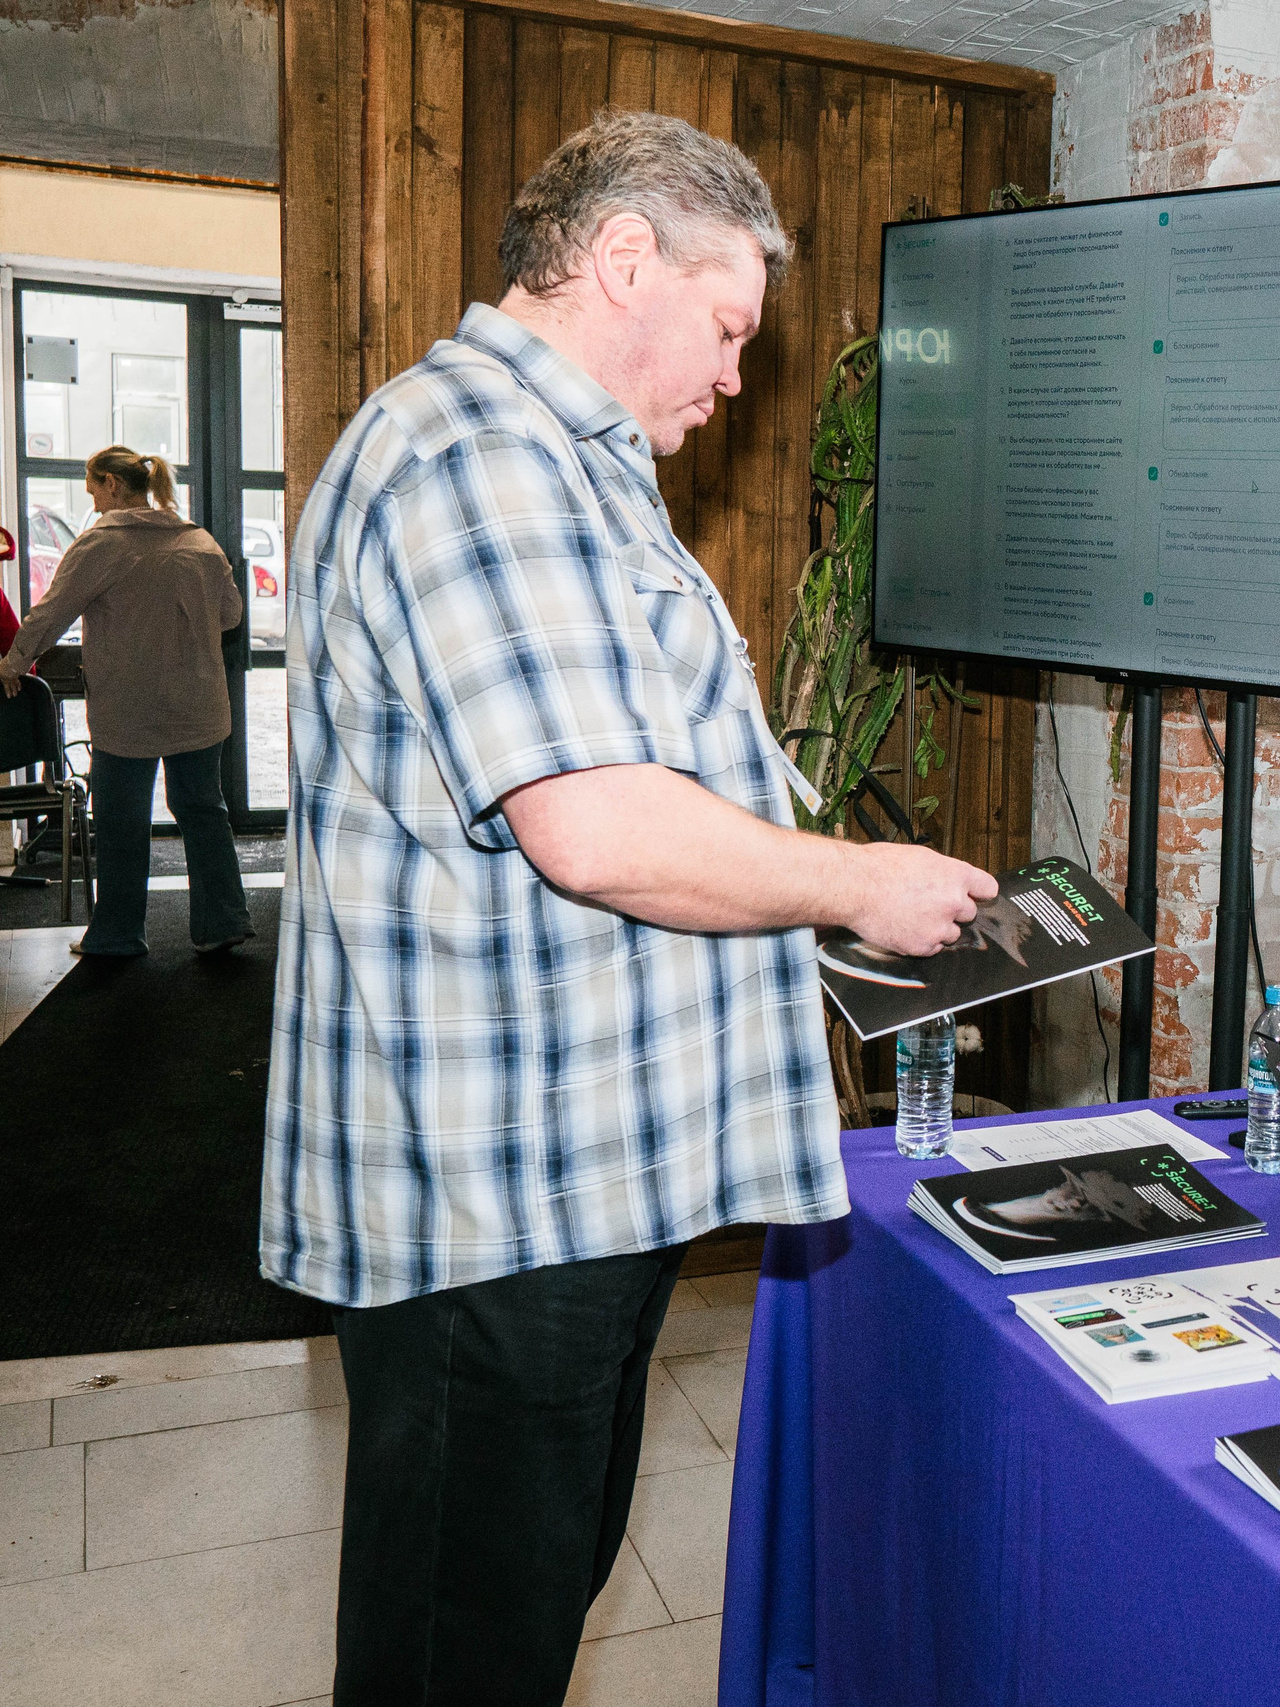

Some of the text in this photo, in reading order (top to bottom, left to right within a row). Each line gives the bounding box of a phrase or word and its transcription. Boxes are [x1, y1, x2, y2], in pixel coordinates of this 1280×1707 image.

[1170, 247, 1205, 255] Пояснение
[1176, 274, 1196, 283] Верно.
[1199, 272, 1234, 282] Обработка
[1165, 375, 1199, 383] Пояснение
[1170, 403, 1191, 412] Верно.
[1193, 403, 1228, 412] Обработка
[1230, 404, 1277, 412] персональных
[1160, 502, 1194, 511] Пояснение
[1165, 530, 1186, 539] Верно.
[1188, 531, 1223, 540] Обработка
[1155, 628, 1189, 638] Пояснение
[1195, 634, 1215, 642] ответу
[1046, 873, 1104, 922] SECURE-T
[1166, 1171, 1217, 1210] SECURE-T
